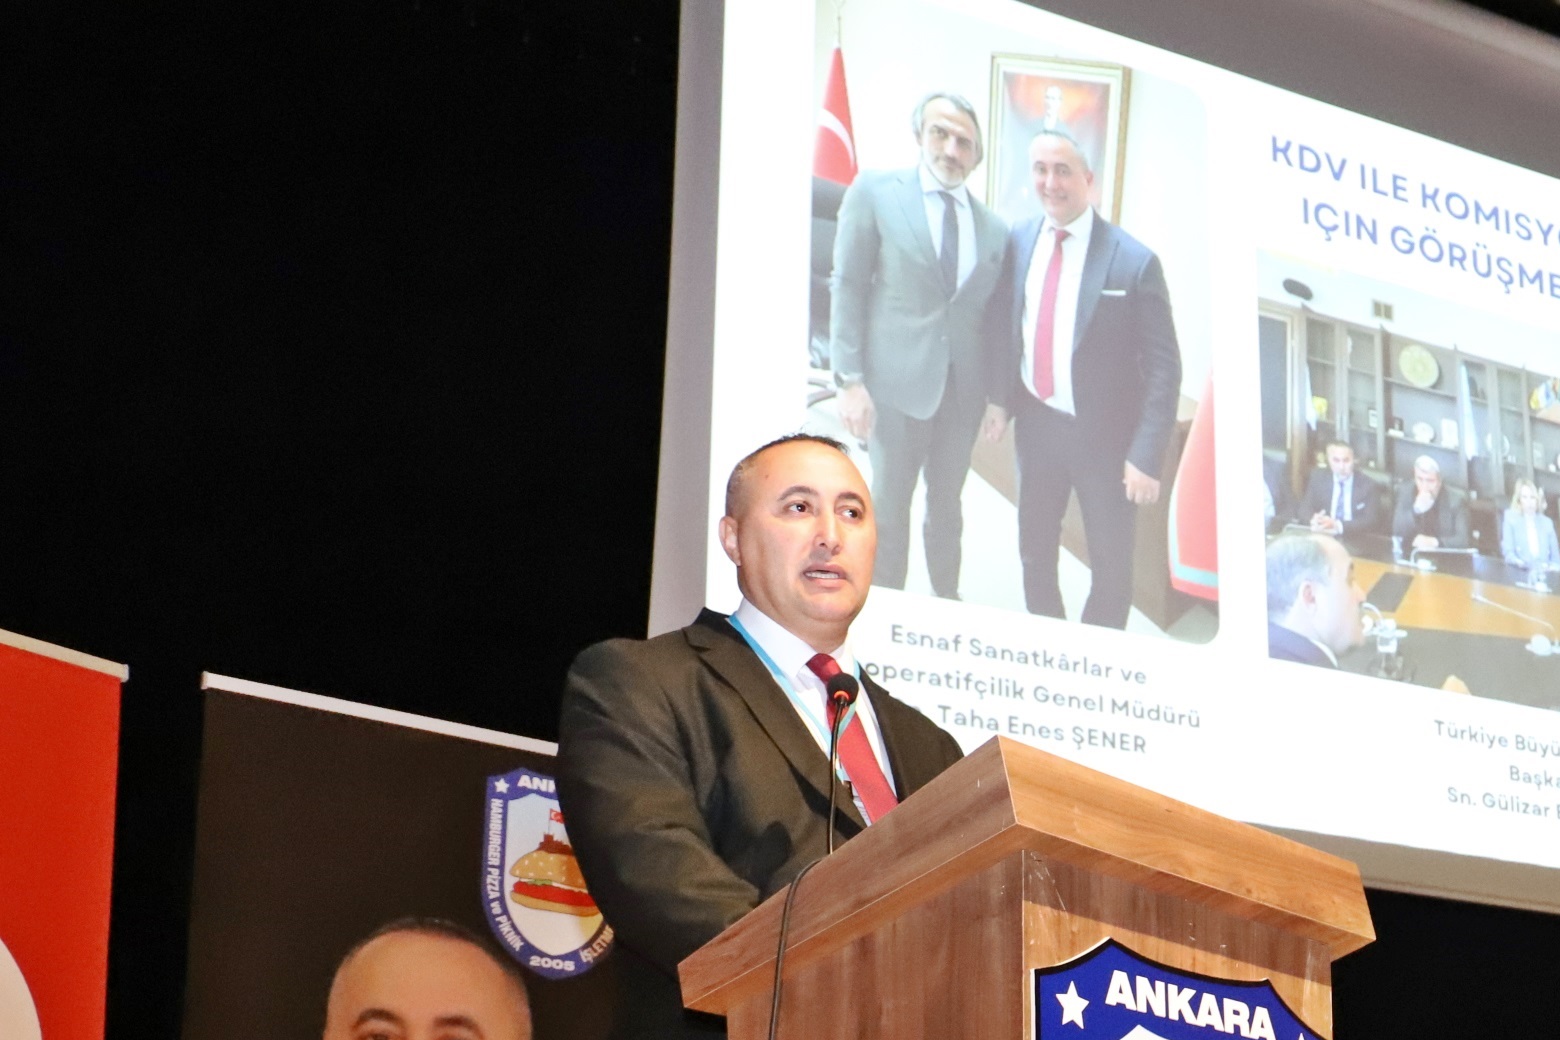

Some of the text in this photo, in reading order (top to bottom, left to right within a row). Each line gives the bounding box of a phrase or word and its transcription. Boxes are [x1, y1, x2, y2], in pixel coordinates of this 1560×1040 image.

[1271, 135, 1349, 183] KDV
[1360, 164, 1409, 203] ILE
[1303, 197, 1378, 245] IÇIN
[891, 624, 1147, 684] Esnaf Sanatkârlar ve
[865, 662, 1201, 729] operatifçilik Genel Müdürü
[938, 704, 1147, 754] Taha Enes ŞENER
[1434, 719, 1509, 748] Türkiye
[1447, 786, 1477, 807] Sn.
[1482, 791, 1550, 818] Gülizar
[529, 955, 576, 971] 2005
